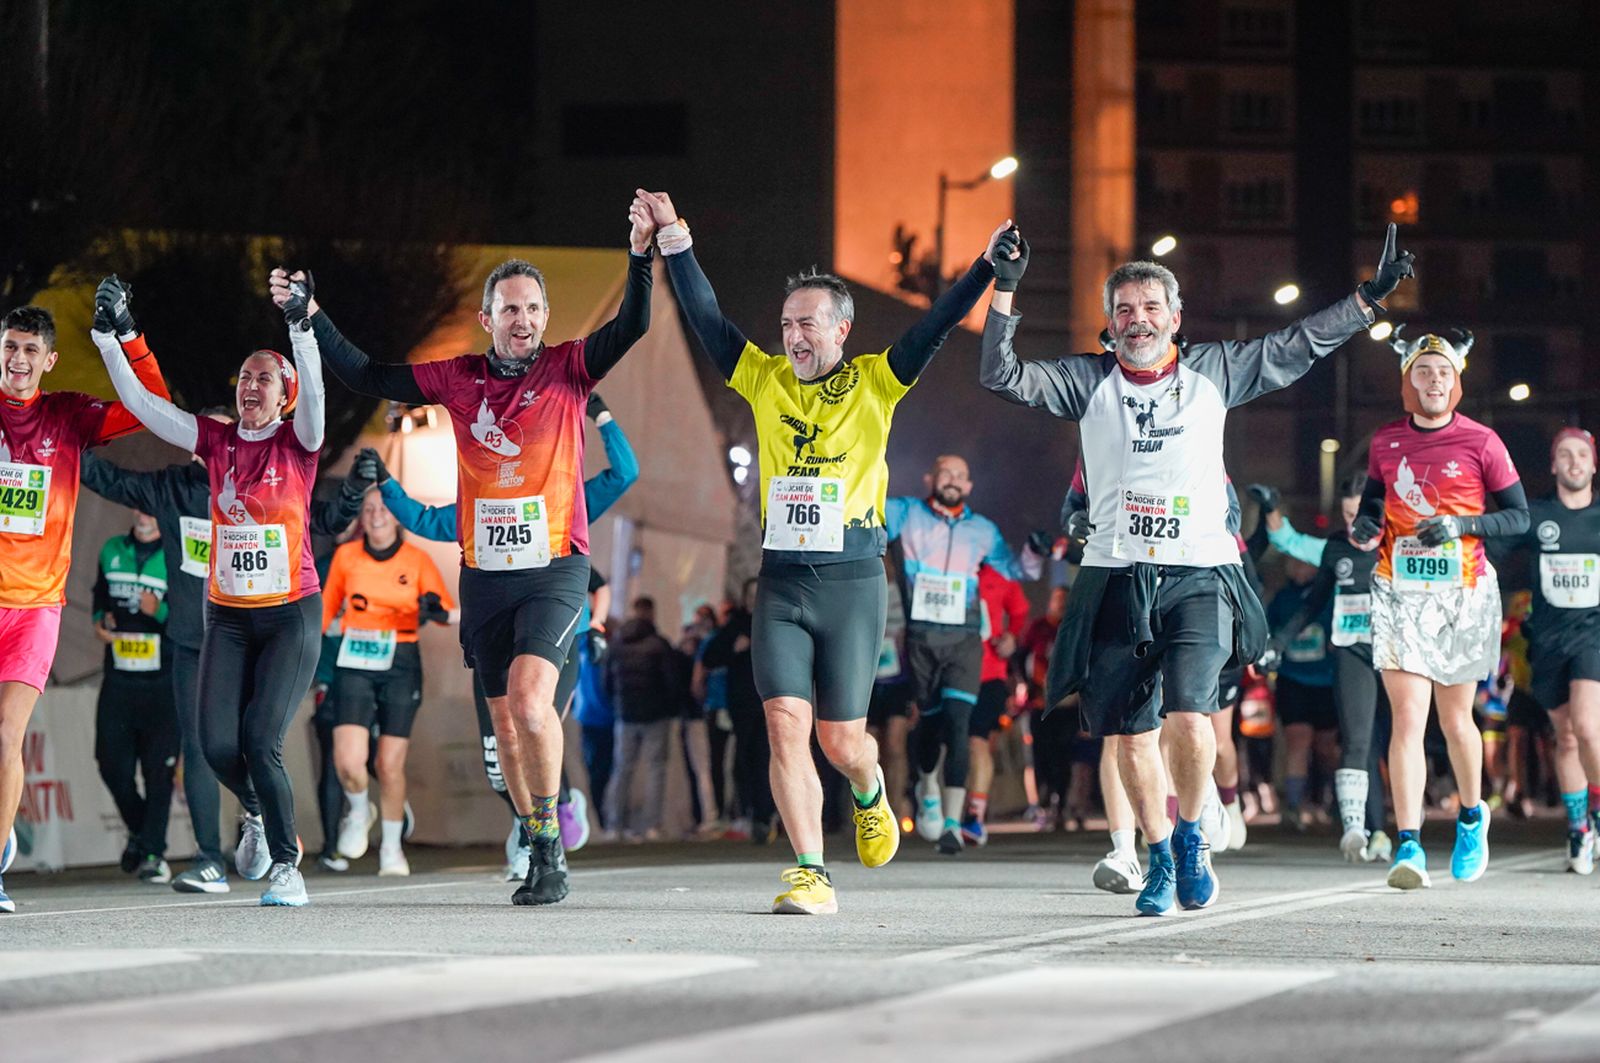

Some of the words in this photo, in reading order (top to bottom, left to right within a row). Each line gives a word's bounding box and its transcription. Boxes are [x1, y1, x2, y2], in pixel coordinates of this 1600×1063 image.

[484, 431, 503, 448] 43
[1131, 439, 1164, 453] TEAM
[786, 466, 821, 478] TEAM
[0, 488, 38, 510] 429
[1133, 496, 1156, 505] NOCHE
[1405, 489, 1421, 507] 43
[227, 504, 247, 524] 43
[786, 503, 821, 525] 766
[1125, 503, 1139, 512] SAN
[486, 524, 532, 546] 7245
[1128, 513, 1181, 540] 3823
[231, 550, 268, 572] 486
[1406, 557, 1449, 576] 8799
[1552, 574, 1590, 588] 6603
